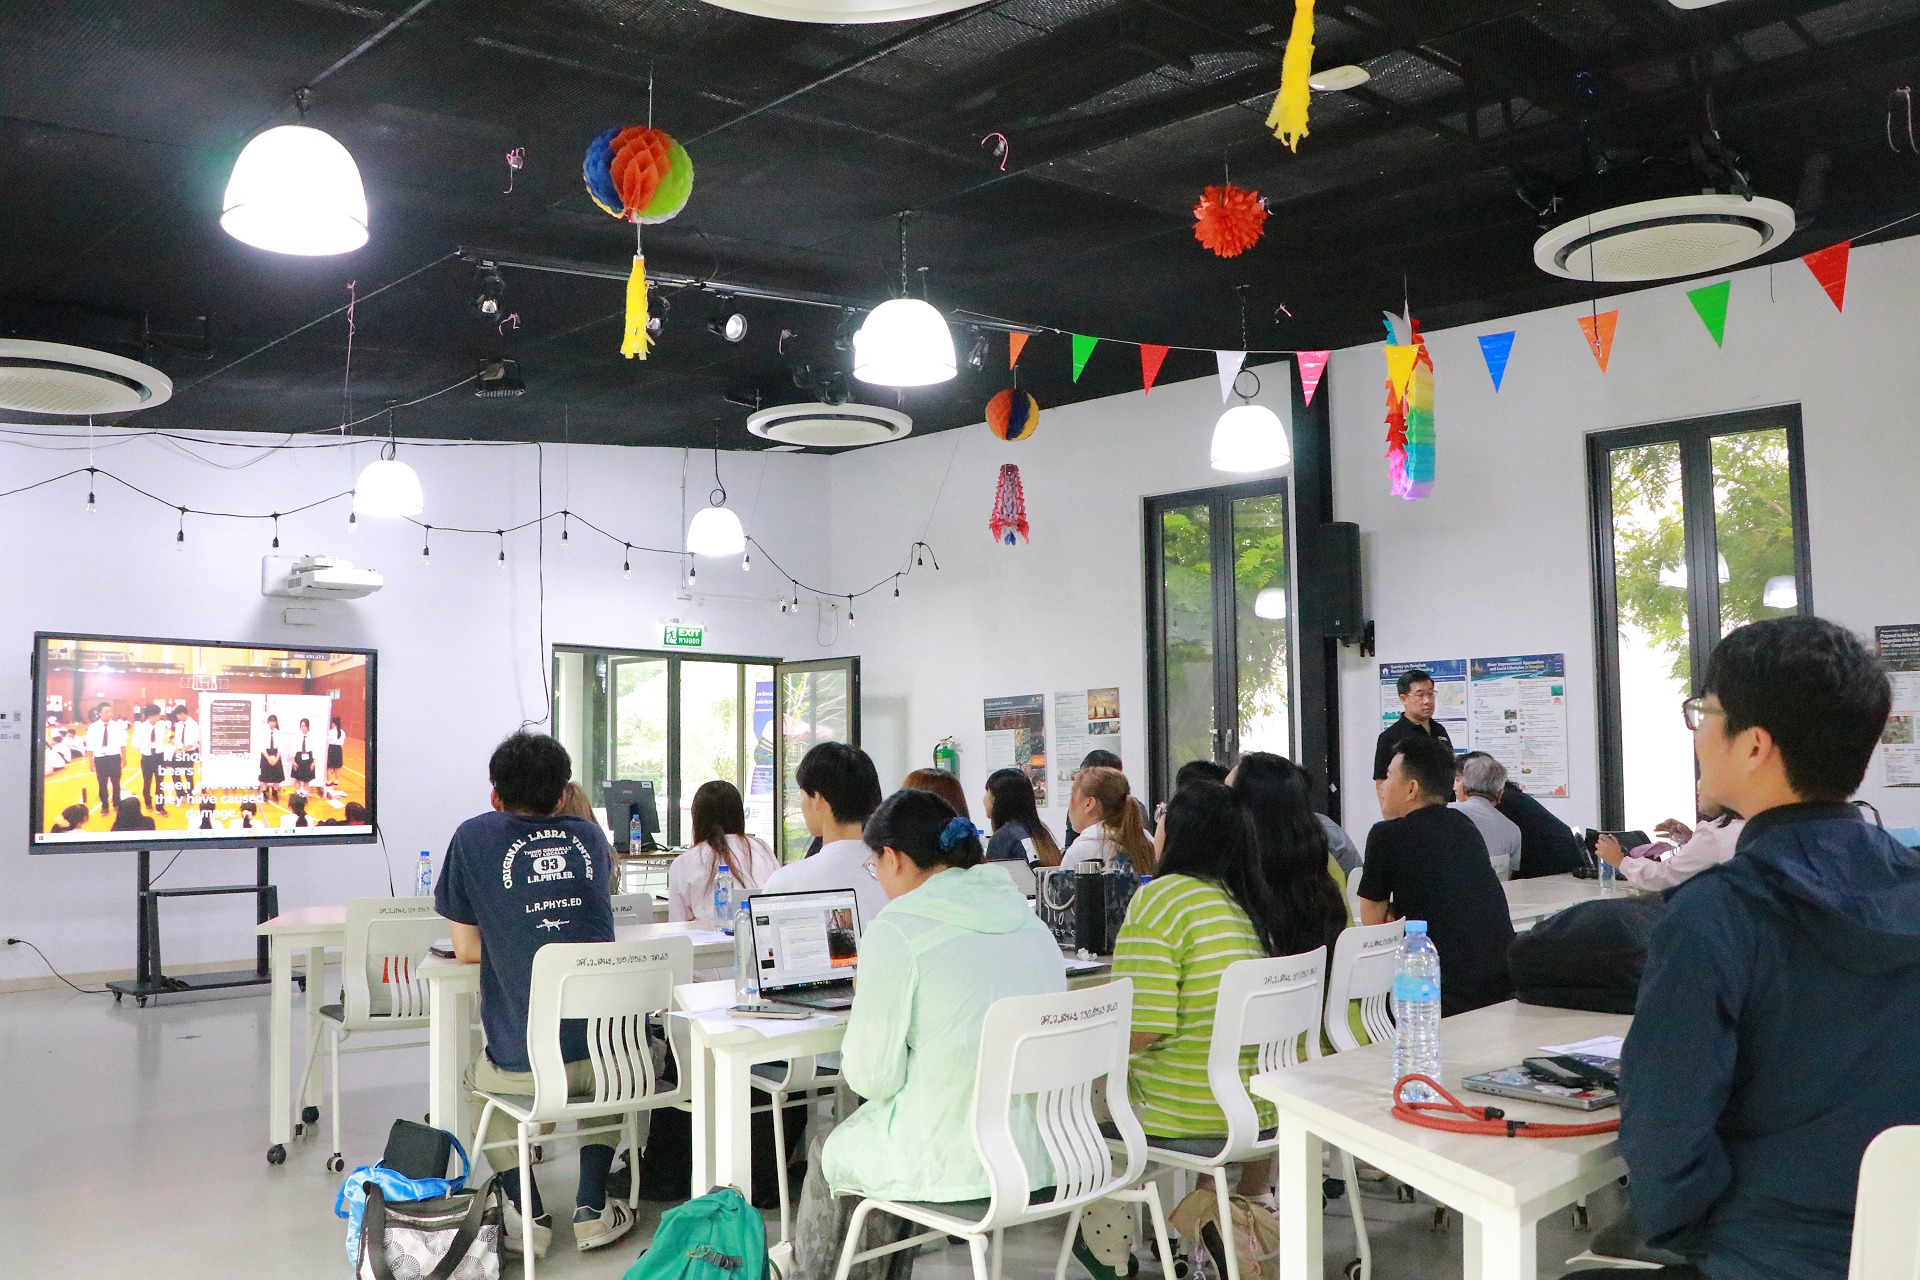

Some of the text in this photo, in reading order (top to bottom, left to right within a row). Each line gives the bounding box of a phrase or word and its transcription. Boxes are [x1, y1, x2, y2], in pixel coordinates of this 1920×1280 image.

[678, 629, 701, 637] EXIT
[154, 792, 265, 808] they have caused
[502, 829, 594, 890] ORIGINAL LABRA VINTAGE
[540, 858, 559, 872] 93
[525, 897, 582, 914] L.R.PHYS.ED
